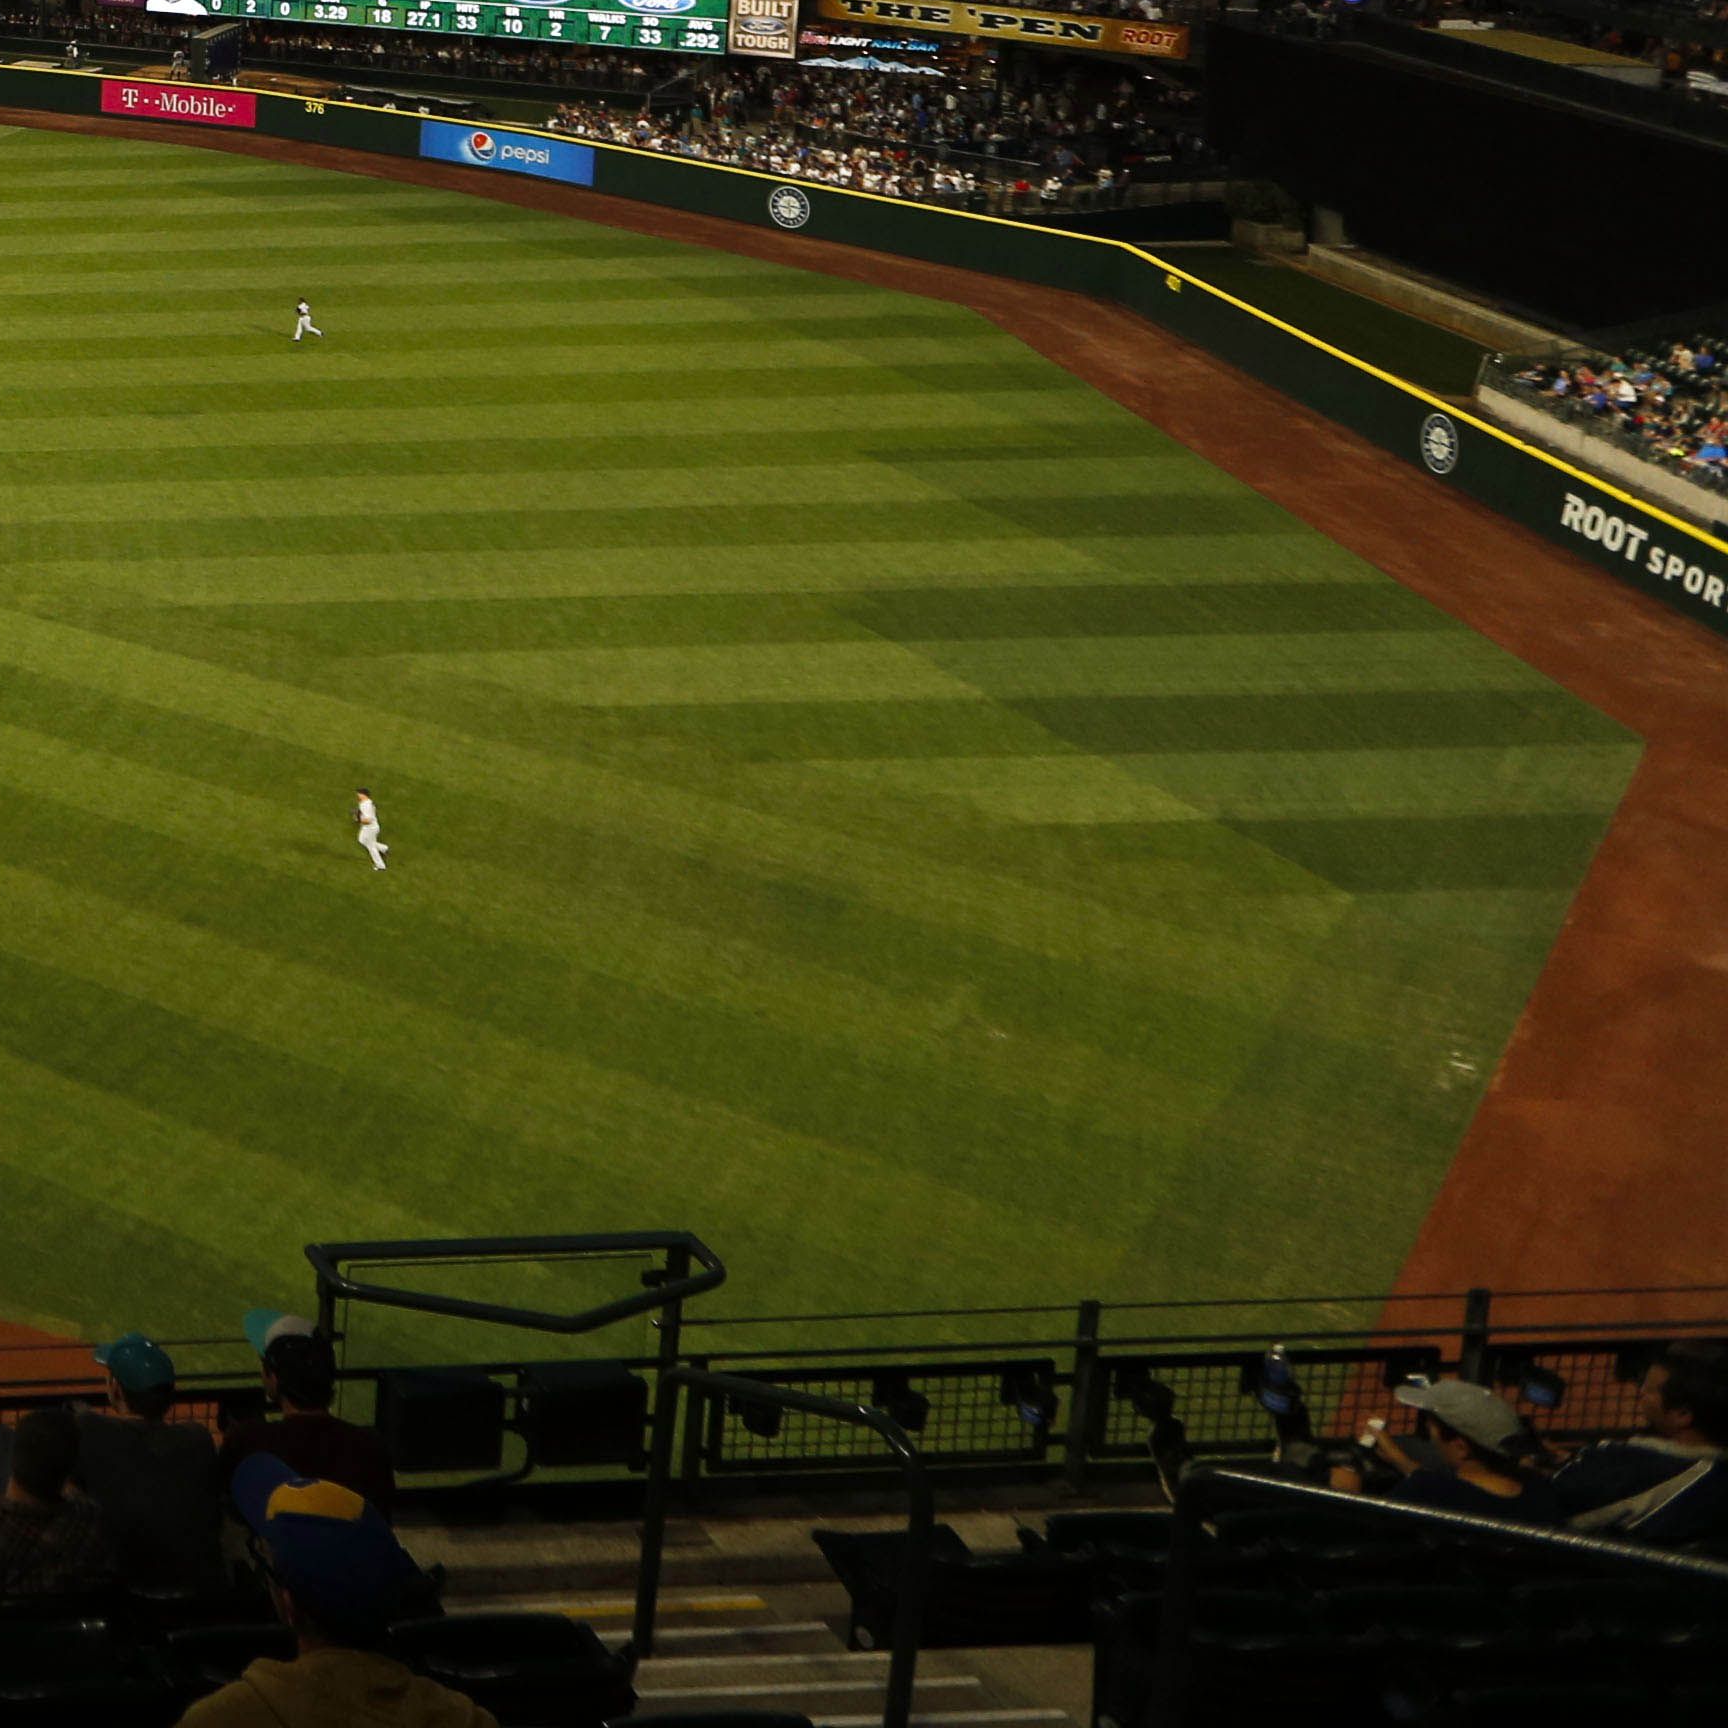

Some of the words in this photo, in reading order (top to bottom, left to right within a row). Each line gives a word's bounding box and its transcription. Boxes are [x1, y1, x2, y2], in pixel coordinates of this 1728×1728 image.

[246, 0, 256, 13] 2
[280, 1, 290, 15] 0
[314, 4, 348, 20] 3.29
[372, 9, 392, 24] 18
[406, 11, 440, 27] 27.1
[456, 15, 477, 30] 33
[502, 19, 523, 33] 10
[550, 22, 562, 37] 2
[600, 26, 611, 41] 7
[639, 28, 662, 44] 33
[679, 33, 719, 49] .292
[456, 3, 480, 14] HITS
[505, 6, 520, 16] ER
[549, 10, 565, 20] HR
[588, 12, 626, 24] WALKS
[642, 17, 659, 27] SO
[688, 20, 713, 31] AVG
[735, 33, 790, 50] TOUGH
[828, 36, 872, 47] LIGHT
[1123, 27, 1178, 48] ROOT
[305, 101, 325, 115] 376
[501, 143, 550, 164] pepsi
[1560, 492, 1649, 562] ROOT
[1645, 546, 1728, 614] SPOR
